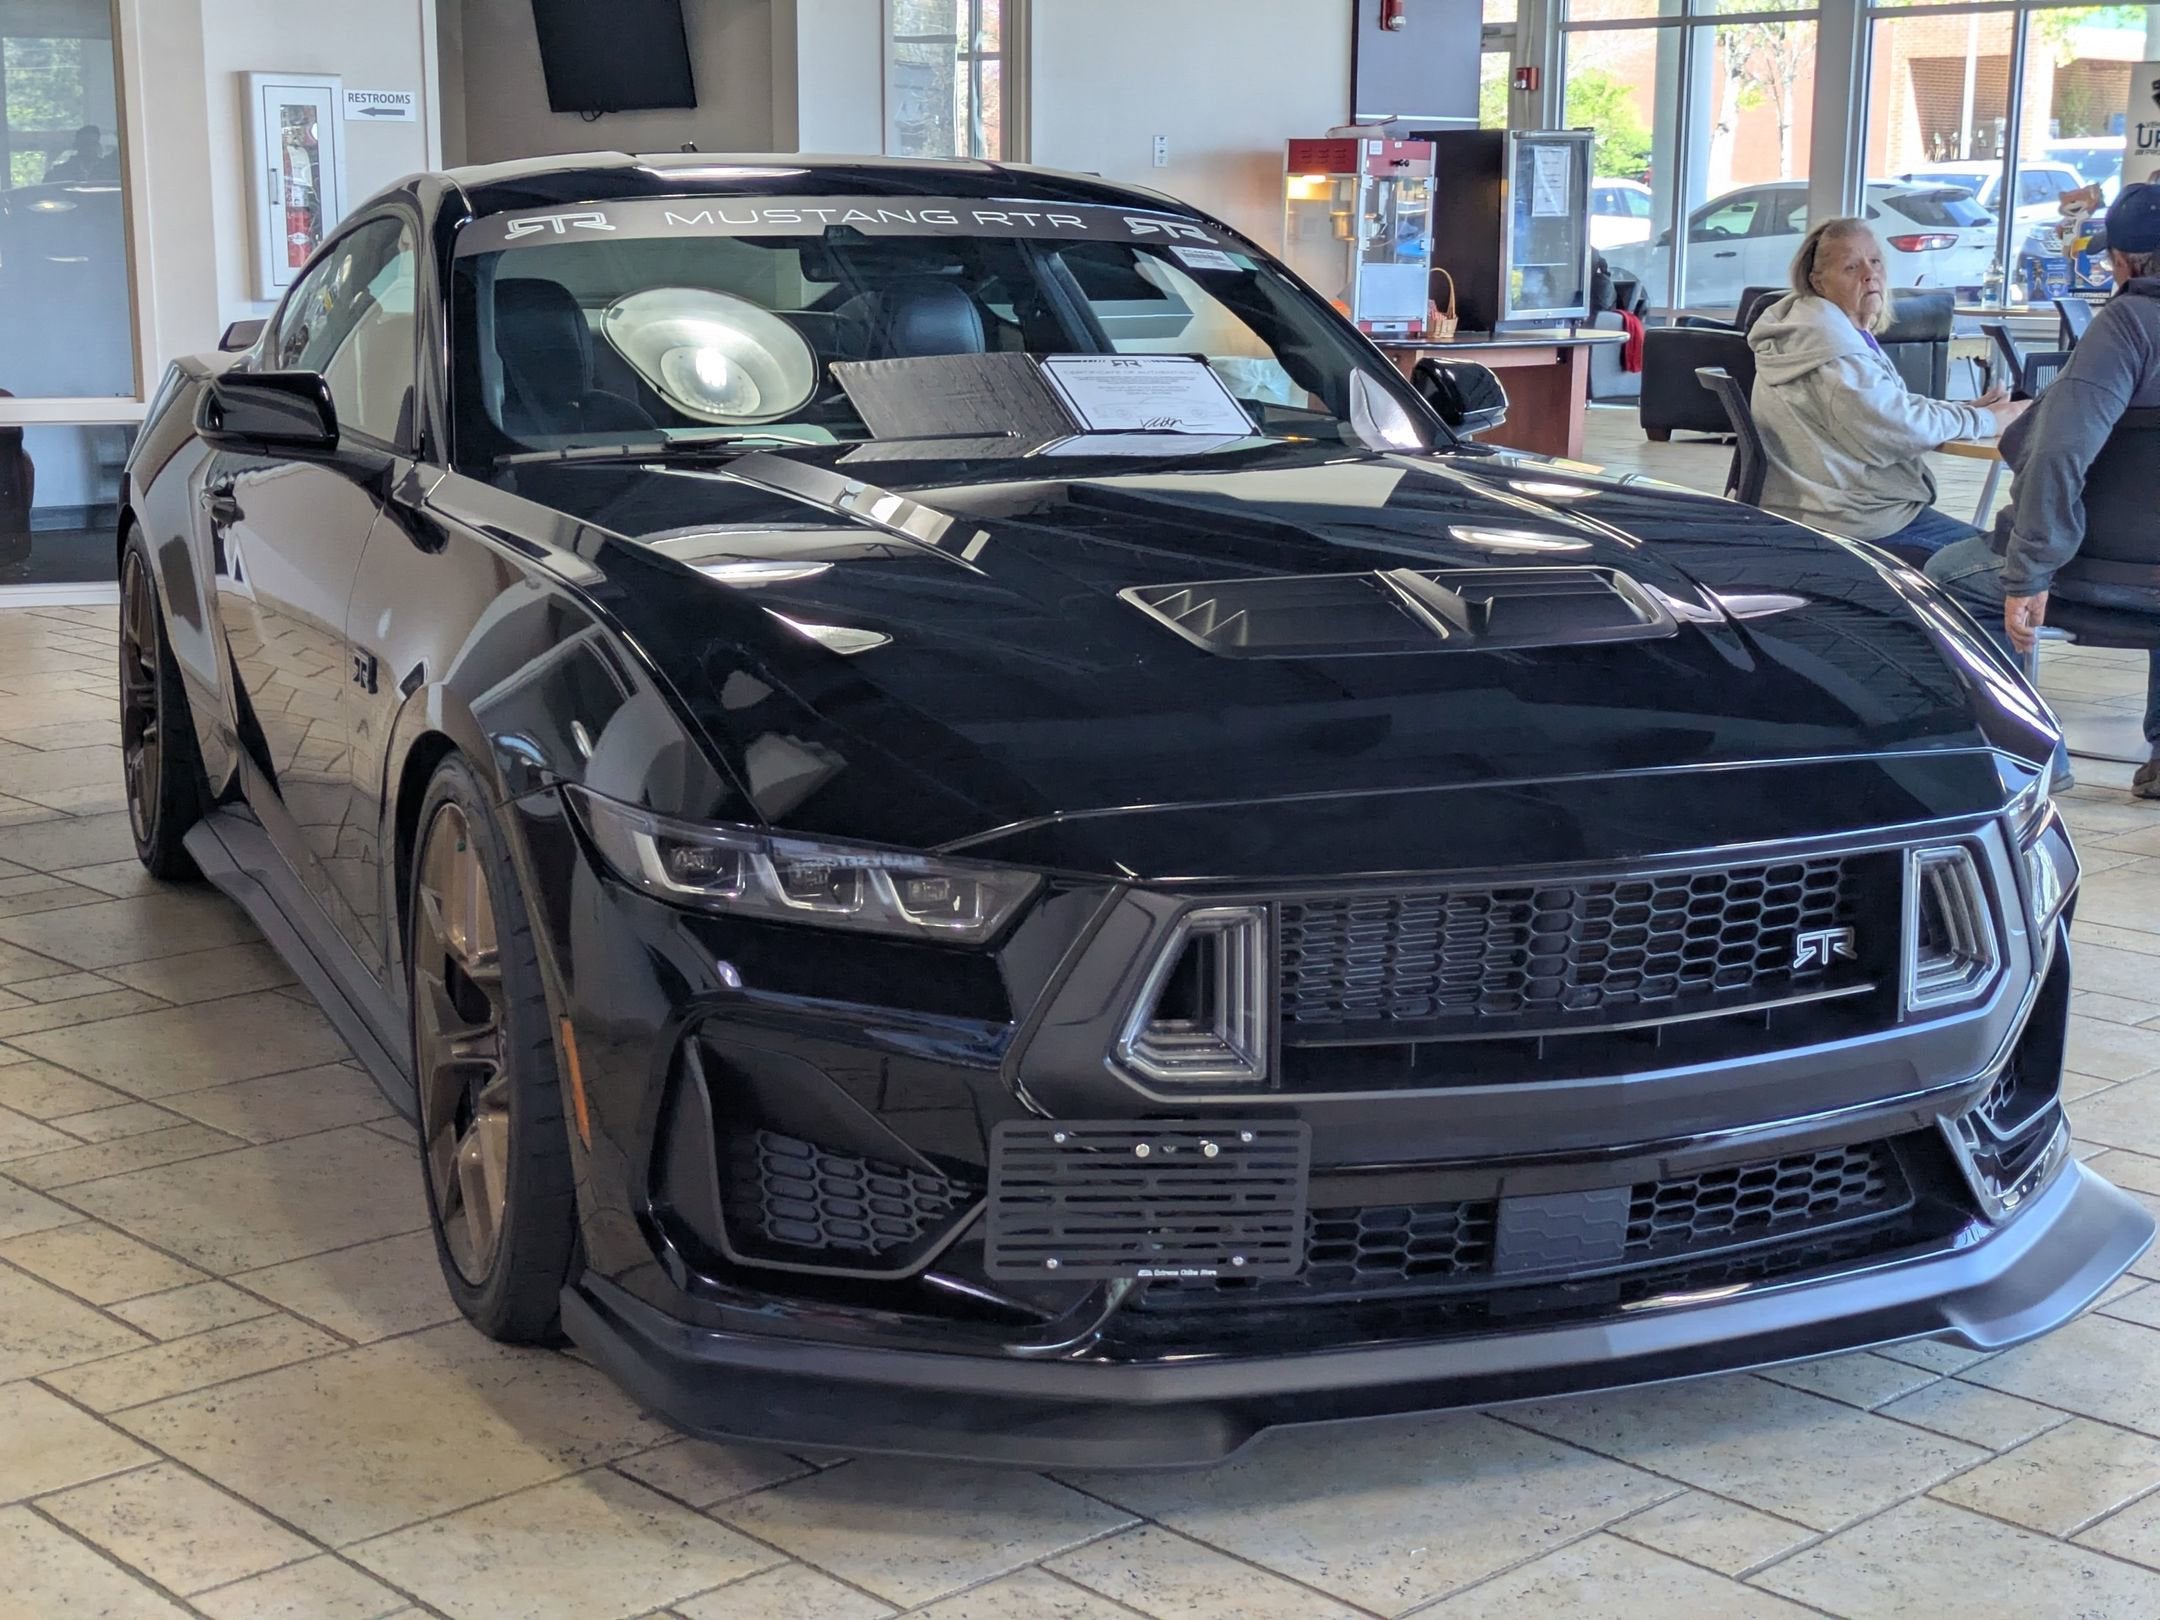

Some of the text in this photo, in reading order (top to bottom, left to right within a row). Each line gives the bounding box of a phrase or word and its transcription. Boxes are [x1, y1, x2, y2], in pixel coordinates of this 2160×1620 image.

[348, 92, 411, 105] RESTROOMS
[505, 212, 616, 240] RTR
[664, 209, 1087, 229] MUSTANG RTR
[1793, 926, 1858, 969] RTR
